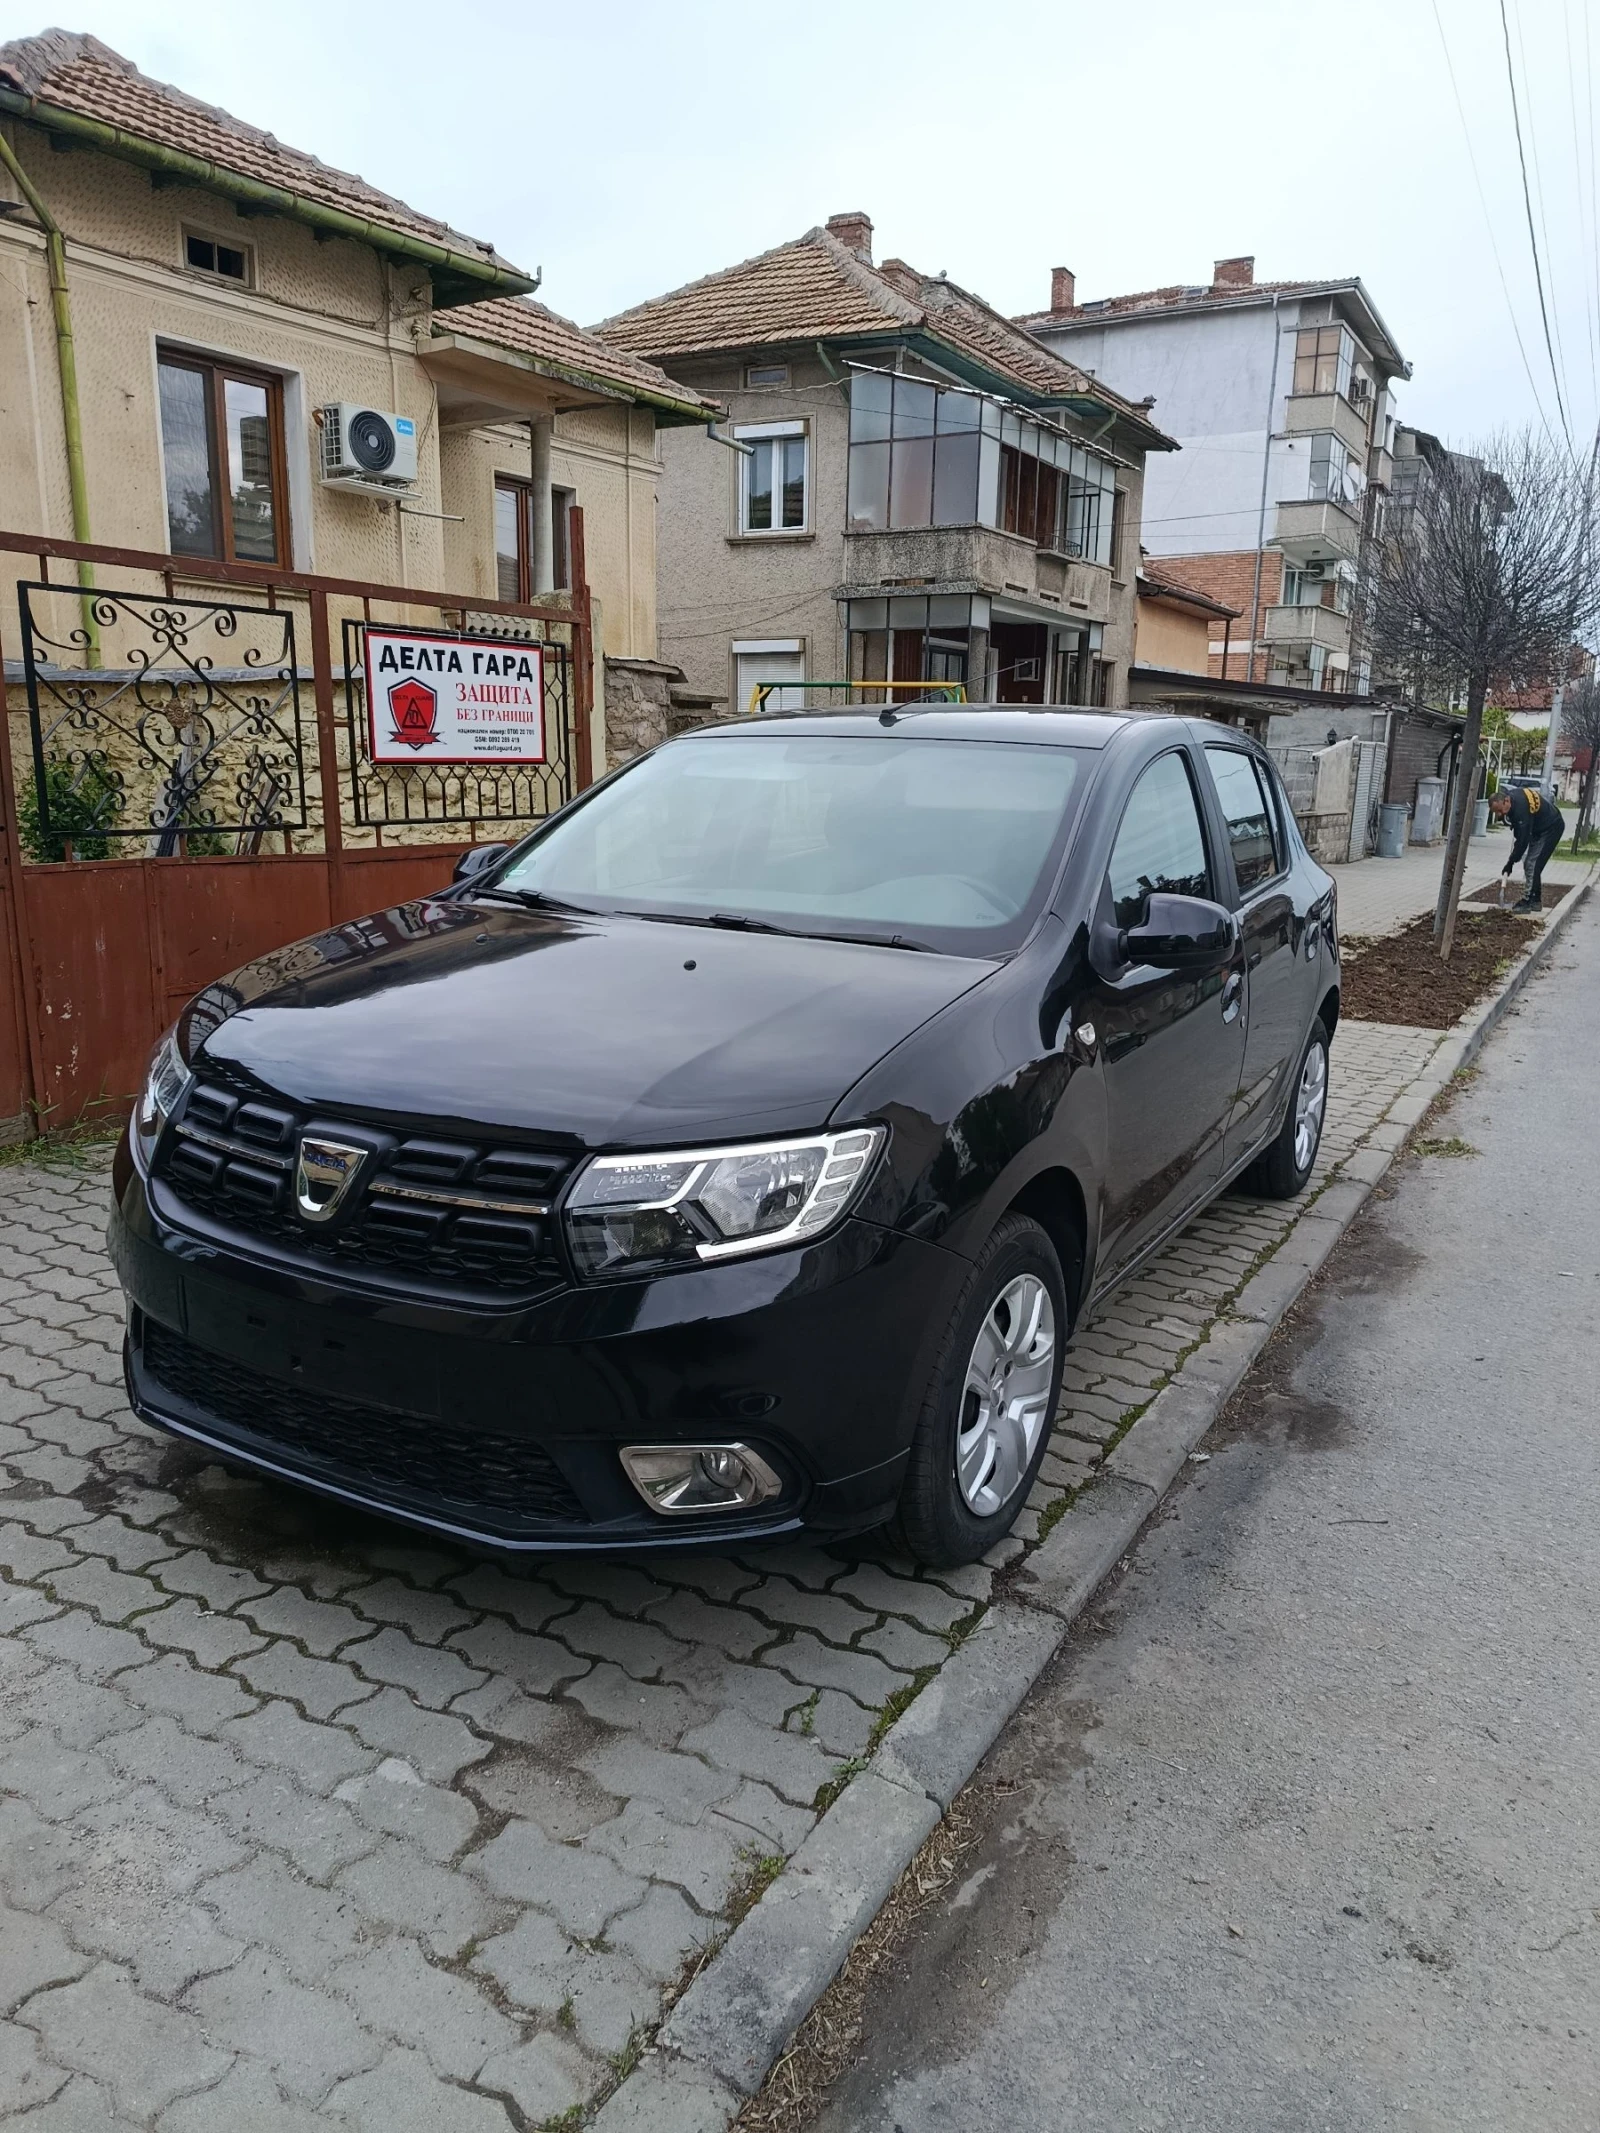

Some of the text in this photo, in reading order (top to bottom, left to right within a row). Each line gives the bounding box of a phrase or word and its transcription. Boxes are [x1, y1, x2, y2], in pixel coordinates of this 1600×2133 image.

[379, 645, 533, 682] ДЕЛТА ГАРД
[455, 682, 532, 706] ЗАЩИТА
[456, 708, 534, 723] БЕЗ ГРАНИЦИ
[305, 1152, 347, 1171] DACIA
